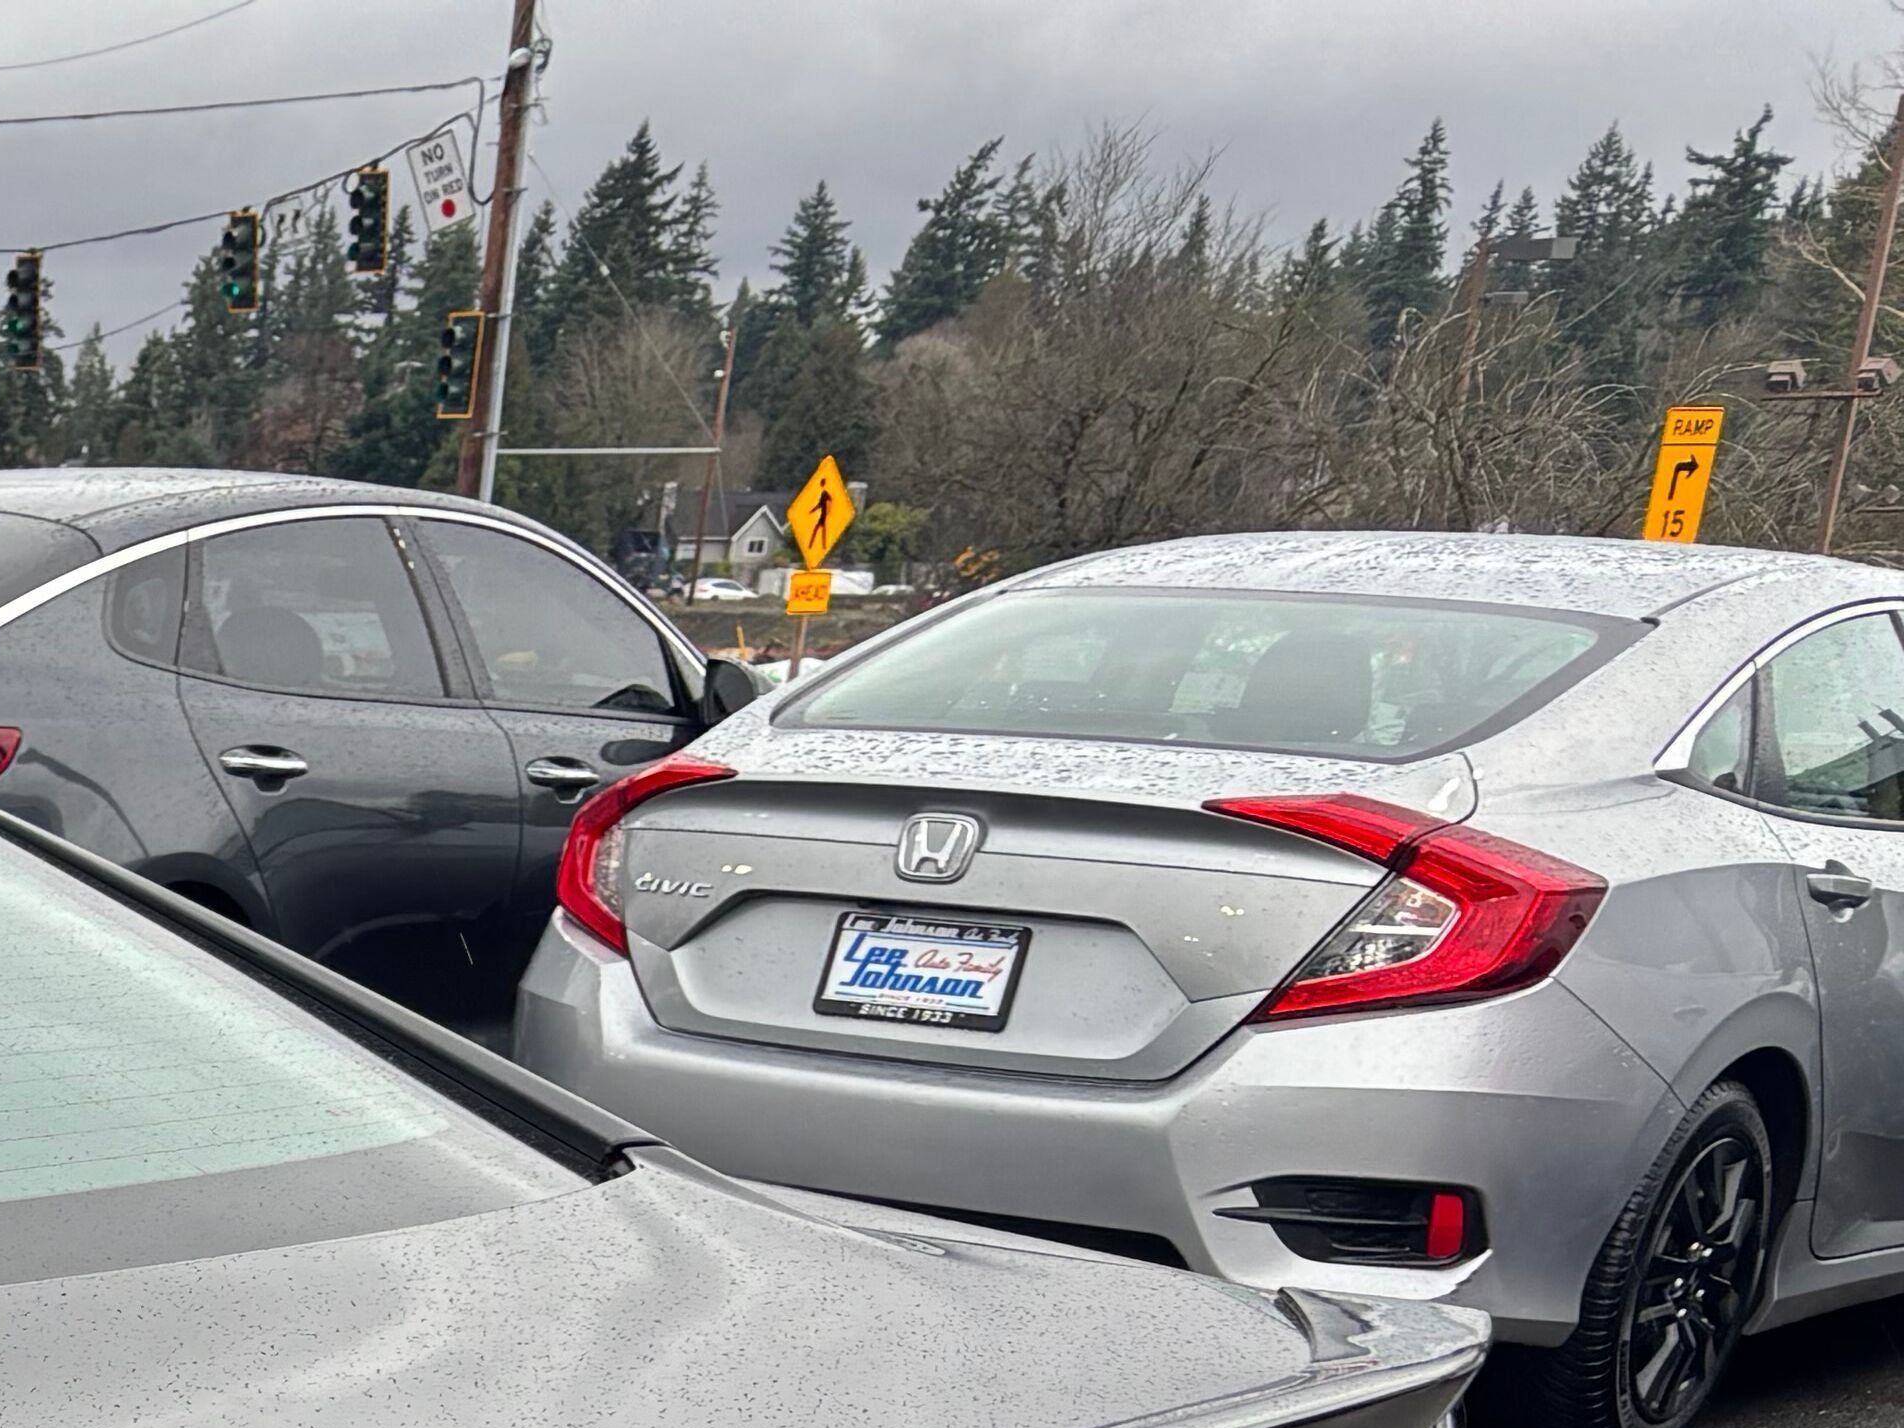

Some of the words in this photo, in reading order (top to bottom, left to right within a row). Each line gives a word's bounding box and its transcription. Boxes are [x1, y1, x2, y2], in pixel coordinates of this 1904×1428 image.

[421, 143, 444, 166] NO
[424, 163, 453, 184] TURN
[1673, 419, 1714, 436] RAMP
[1661, 510, 1685, 537] 15
[635, 874, 713, 897] CIVIC
[881, 917, 959, 938] Johnson
[843, 933, 909, 966] Lee
[914, 949, 951, 970] Auto
[953, 953, 1006, 982] Family
[839, 963, 984, 999] Johnson
[859, 1004, 907, 1019] SINCE
[911, 1009, 953, 1023] 1933
